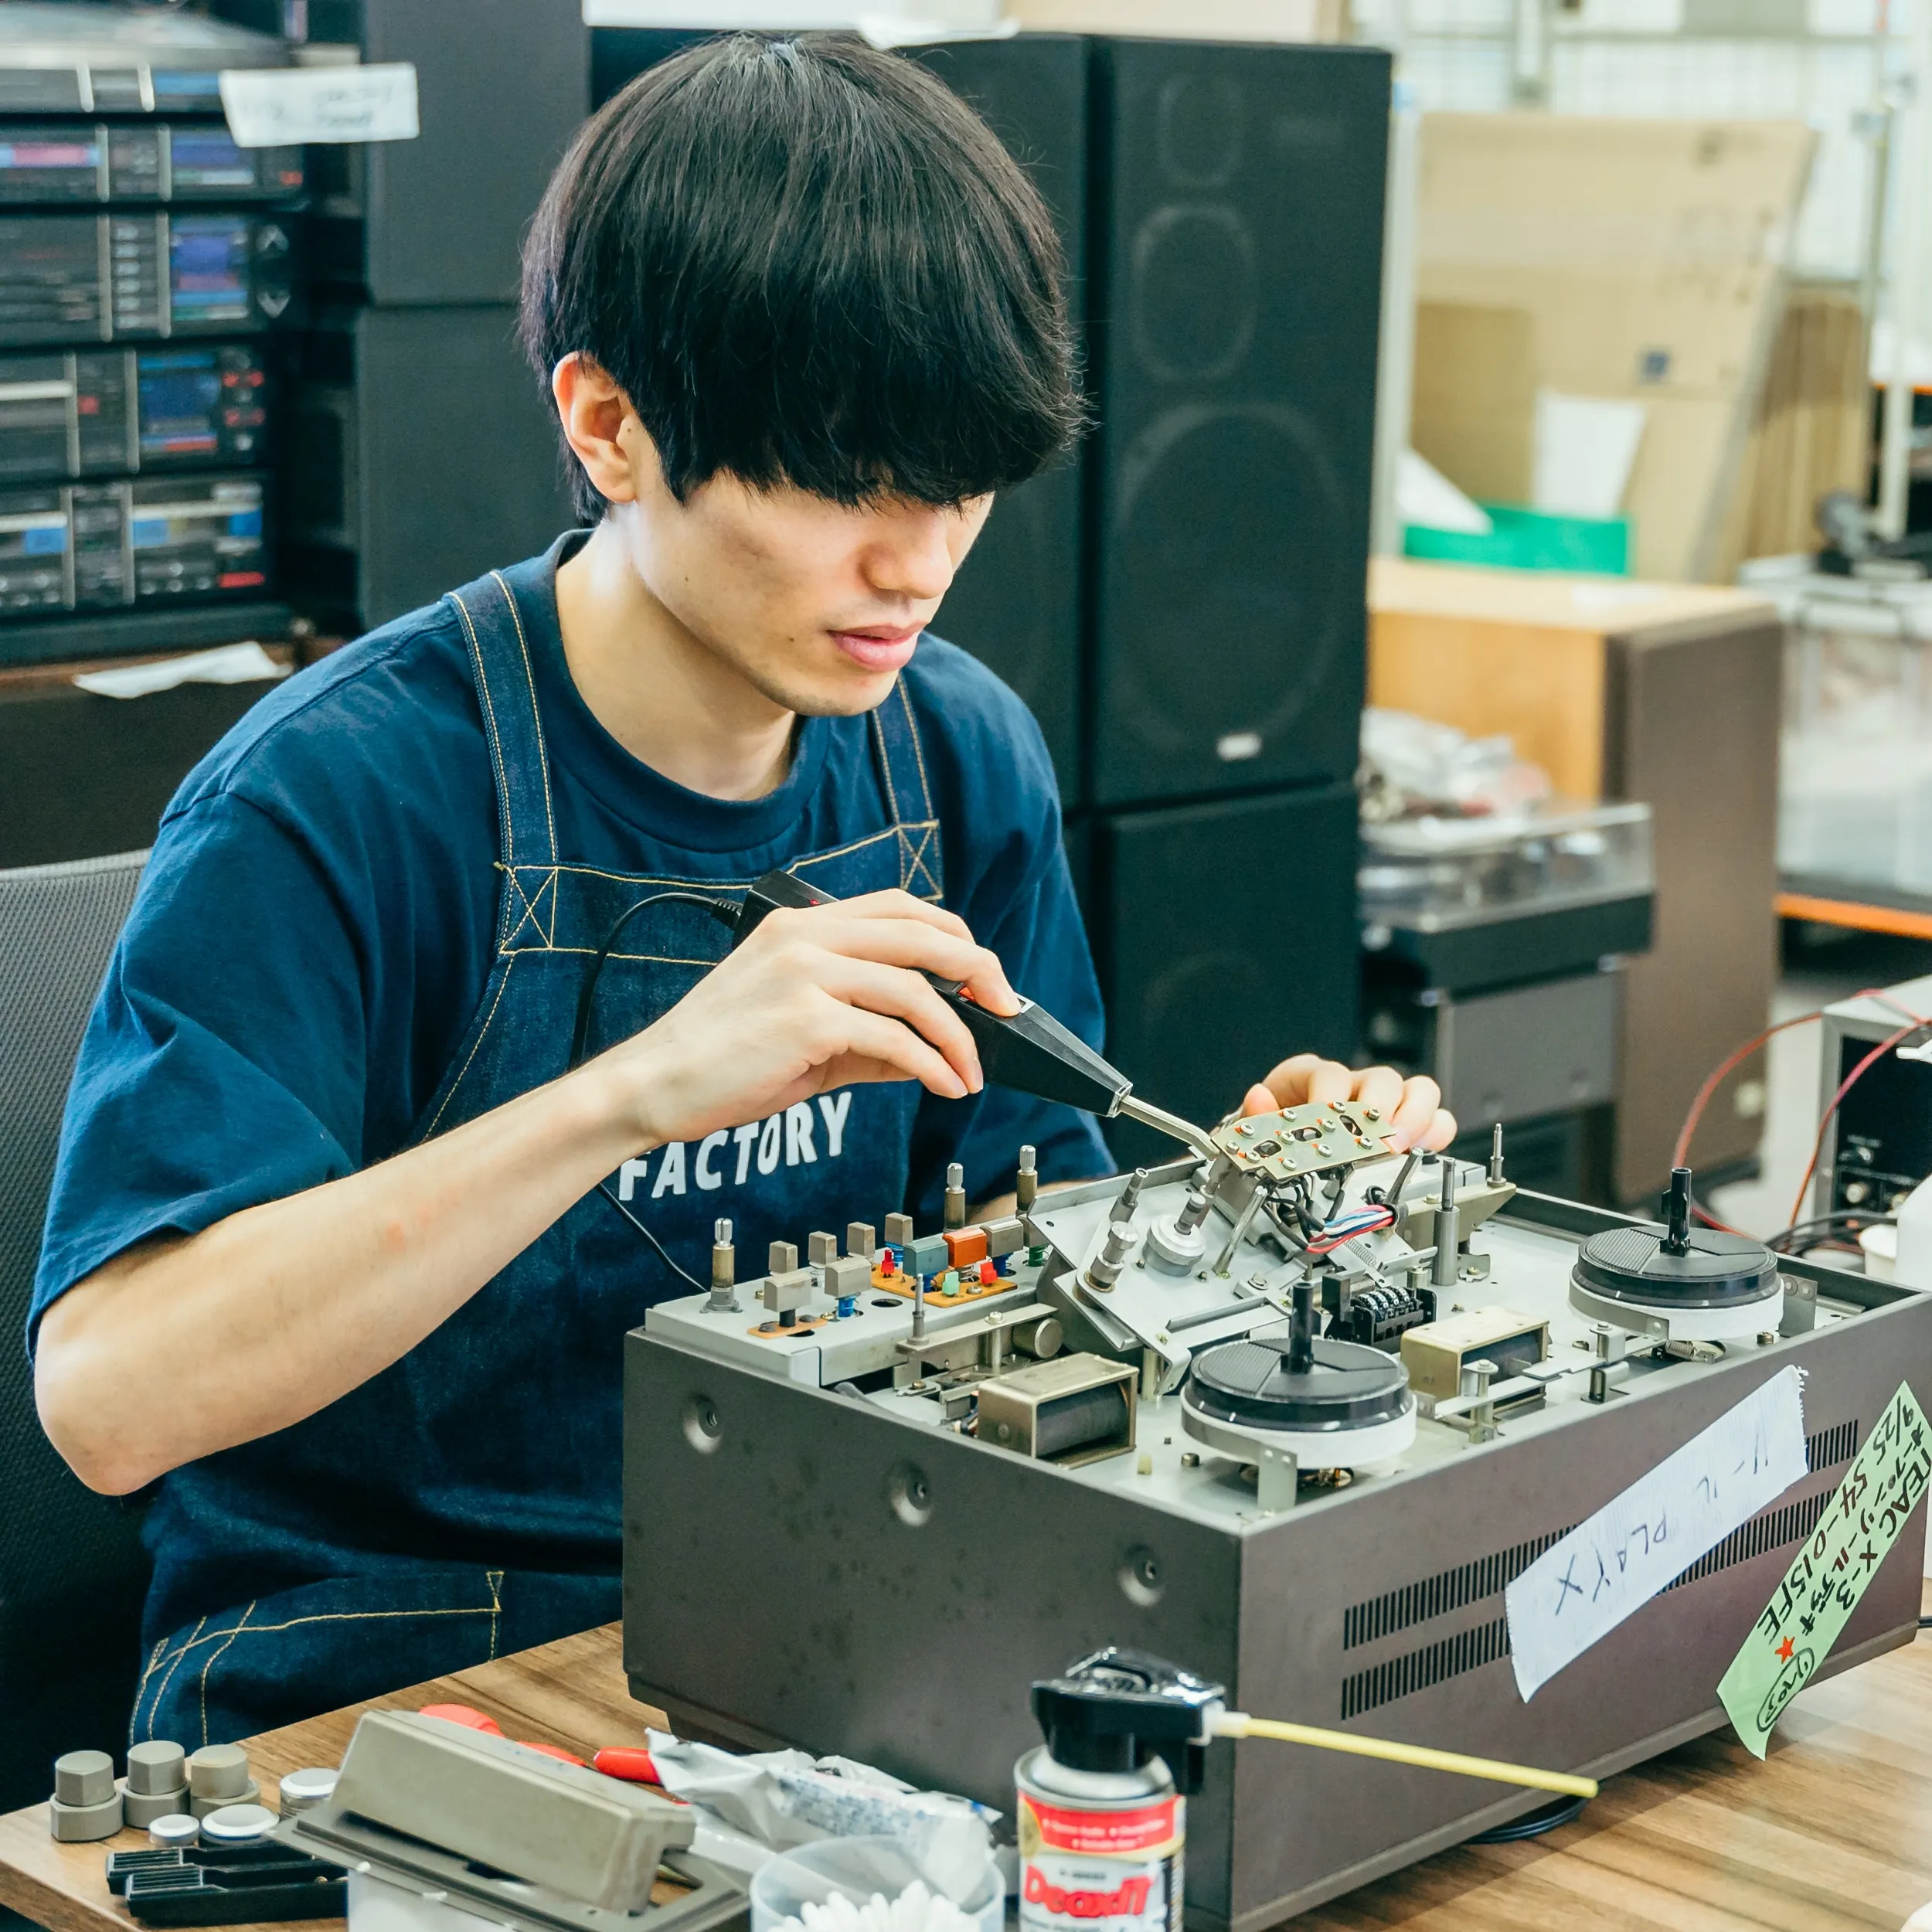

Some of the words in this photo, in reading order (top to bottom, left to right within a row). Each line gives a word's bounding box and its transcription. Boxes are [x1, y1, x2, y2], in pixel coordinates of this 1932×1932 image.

[618, 1091, 852, 1201] FACTORY
[1872, 1396, 1915, 1466] 9/25
[1879, 1447, 1931, 1539] TEAC
[1836, 1540, 1879, 1611] X-3
[1764, 1655, 1809, 1723] リペア
